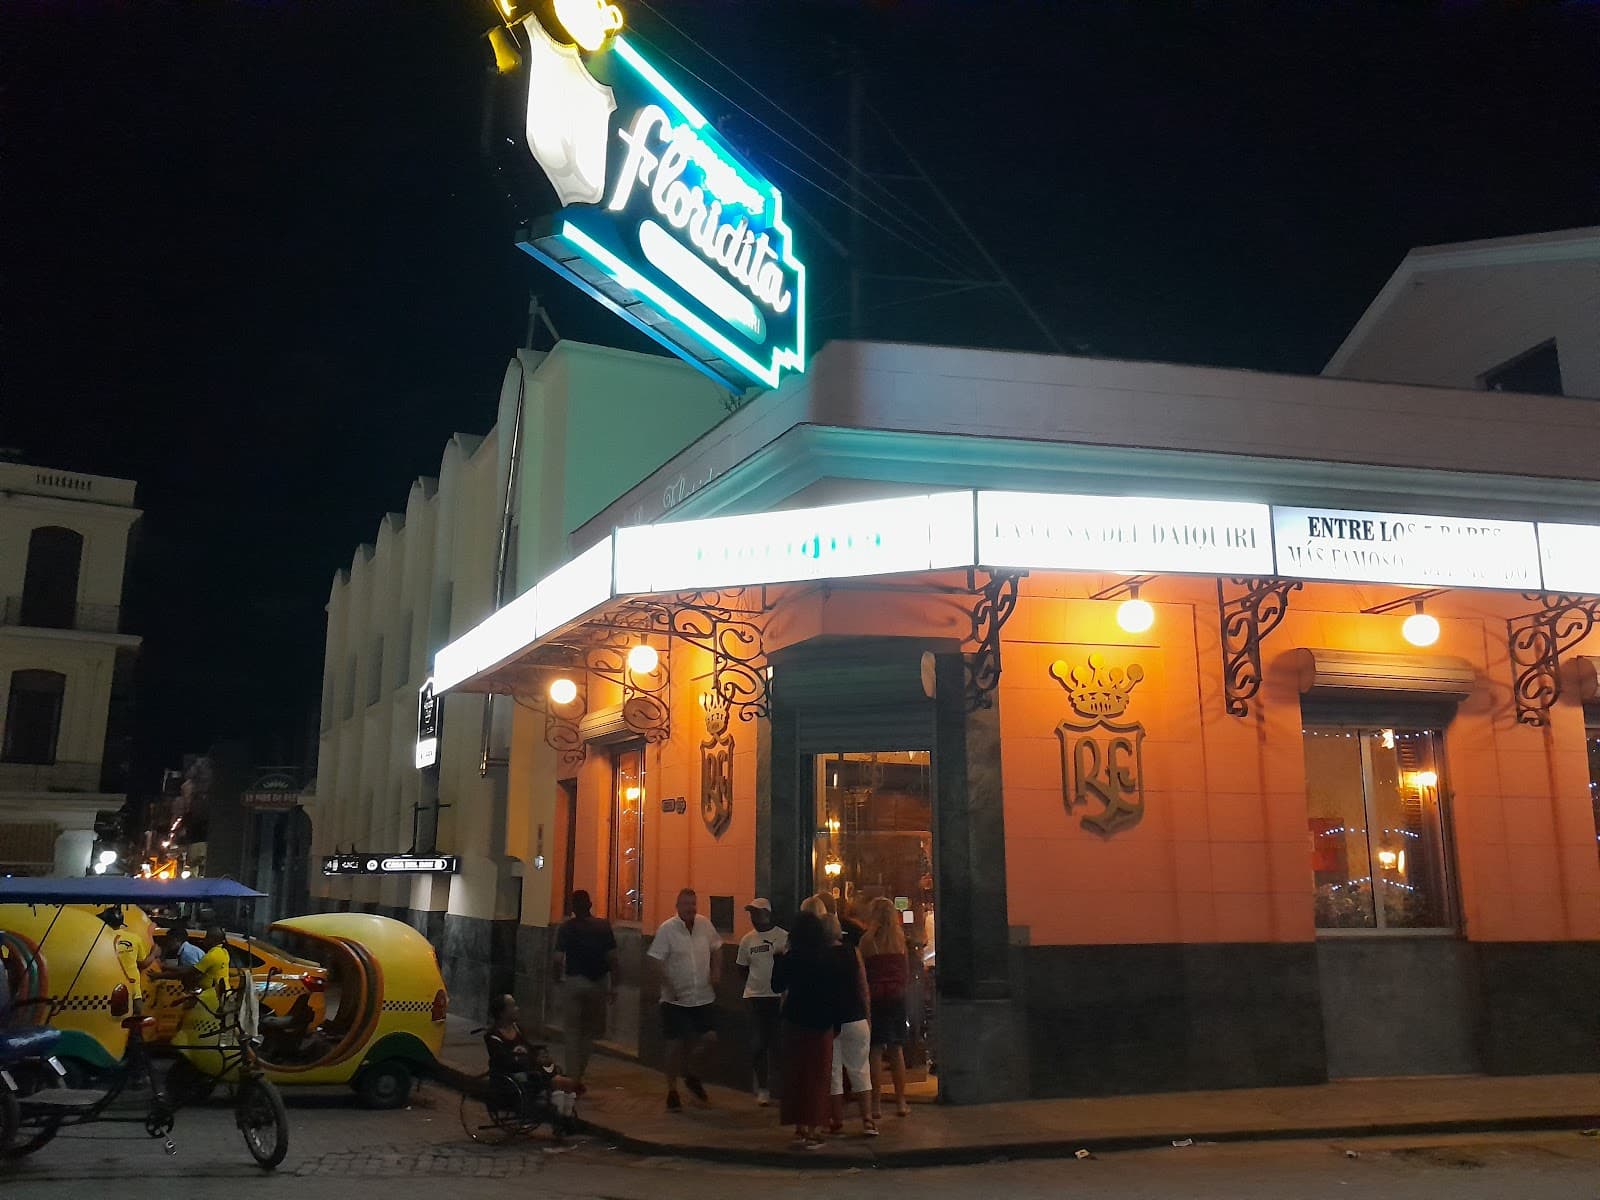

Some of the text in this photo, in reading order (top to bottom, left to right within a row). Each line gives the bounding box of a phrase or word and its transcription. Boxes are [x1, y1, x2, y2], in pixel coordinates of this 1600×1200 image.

[1152, 522, 1257, 550] DAIQUIRI
[1307, 515, 1375, 542] ENTRE
[1381, 520, 1417, 543] LOS
[1332, 548, 1408, 571] FAMOSO
